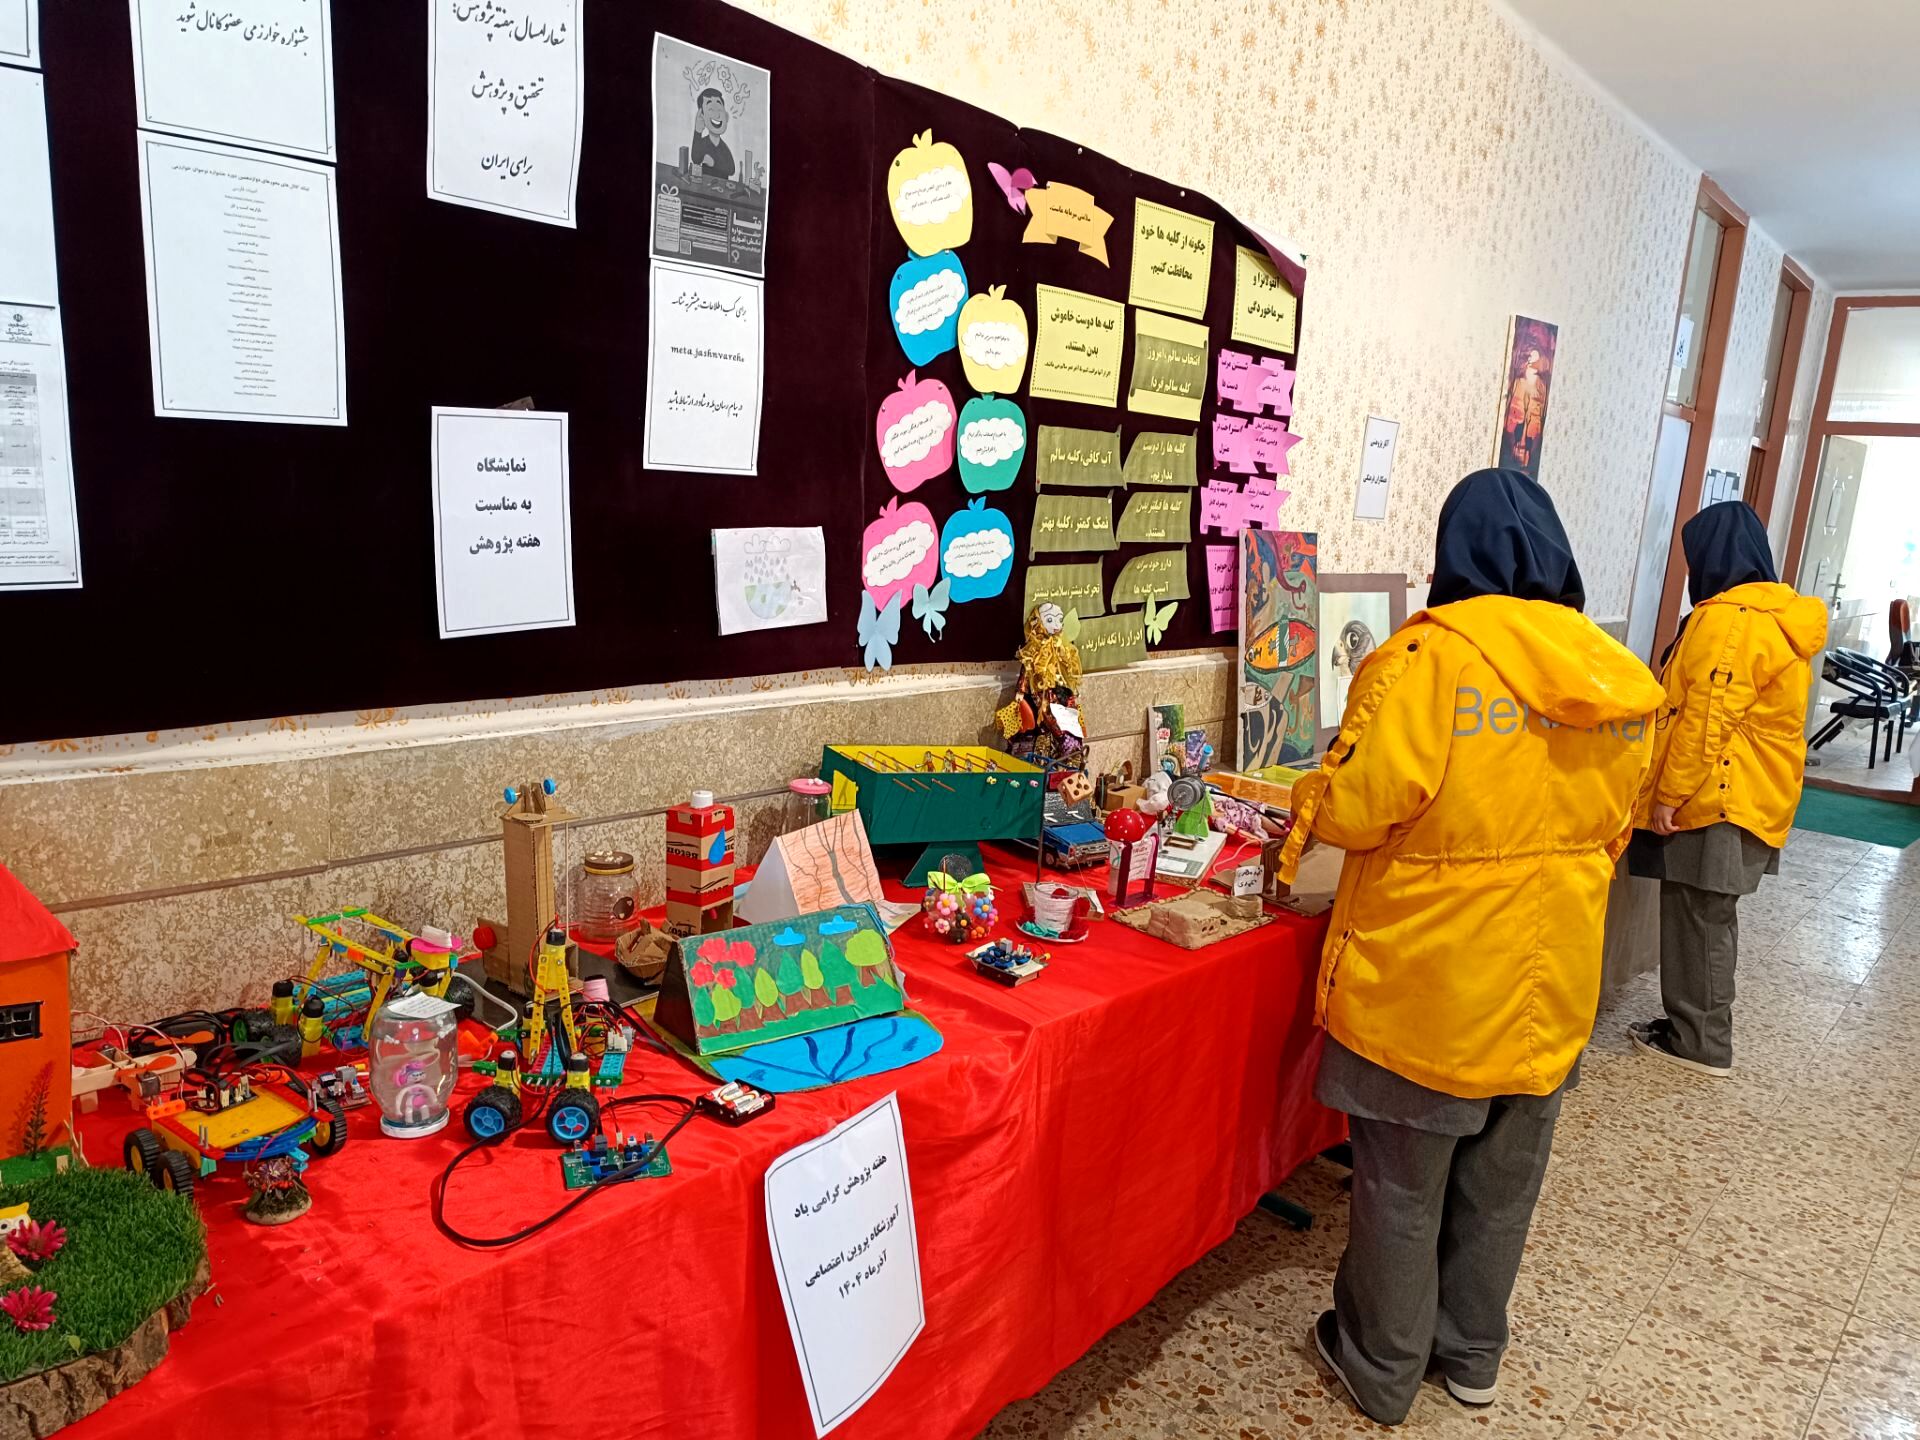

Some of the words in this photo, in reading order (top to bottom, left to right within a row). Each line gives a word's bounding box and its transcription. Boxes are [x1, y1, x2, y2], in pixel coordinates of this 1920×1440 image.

[176, 1, 197, 32] شوید
[196, 10, 228, 31] کانال
[223, 13, 243, 31] عضو
[243, 22, 281, 41] خوارزمی
[514, 15, 547, 42] امسال
[543, 23, 567, 46] شعار
[281, 26, 309, 56] جشنواره
[472, 70, 508, 115] پژوهش
[514, 77, 544, 117] تحقیق
[481, 154, 510, 180] ایران
[510, 156, 534, 186] برای
[1141, 224, 1155, 239] خود
[1157, 225, 1164, 239] ها
[1166, 230, 1181, 246] کلیه
[1180, 234, 1187, 249] از
[1167, 264, 1193, 280] محافظت
[736, 305, 747, 322] برای
[1050, 307, 1075, 323] خاموش
[1247, 300, 1284, 322] سرماخوردگی
[1075, 314, 1094, 329] دوست
[1095, 316, 1102, 328] ها
[1103, 319, 1115, 333] کلیه
[1086, 346, 1099, 358] بدن
[1167, 348, 1181, 363] سالم
[1181, 352, 1201, 367] انتخاب
[1150, 375, 1164, 392] فردا
[1164, 378, 1178, 393] سالم
[1179, 381, 1191, 396] کلیه
[1226, 381, 1239, 391] دست
[1220, 423, 1244, 435] استراحت
[1050, 447, 1066, 463] سالم
[1142, 441, 1160, 455] دوست
[1159, 441, 1166, 456] را
[1166, 441, 1173, 454] ها
[1173, 442, 1187, 456] کلیه
[476, 457, 527, 476] نمایشگاه
[1101, 451, 1112, 468] آب
[475, 496, 518, 516] مناسبت
[520, 497, 532, 514] به
[1162, 500, 1169, 511] ها
[1170, 500, 1182, 513] کلیه
[1039, 516, 1055, 533] بهتر
[1075, 516, 1091, 533] کمتر
[1092, 515, 1109, 529] نمک
[469, 535, 514, 555] پژوهش
[516, 533, 541, 548] هفته
[1149, 559, 1160, 571] خود
[1032, 588, 1050, 602] بیشتر
[1083, 583, 1100, 597] تحرک
[1133, 583, 1140, 594] ها
[1141, 583, 1153, 596] کلیه
[1153, 581, 1169, 595] آسیب
[1117, 632, 1126, 648] را
[1126, 628, 1144, 647] ادرار
[872, 1153, 888, 1171] هفته
[842, 1165, 872, 1196] پژوهش
[811, 1184, 841, 1214] گرامی
[793, 1202, 809, 1219] باد
[869, 1203, 900, 1241] آموزشگاه
[846, 1236, 870, 1262] پروین
[804, 1251, 846, 1288] اعتصامی
[863, 1249, 889, 1279] آذرماه
[838, 1271, 863, 1300] ۱۴۰۴
